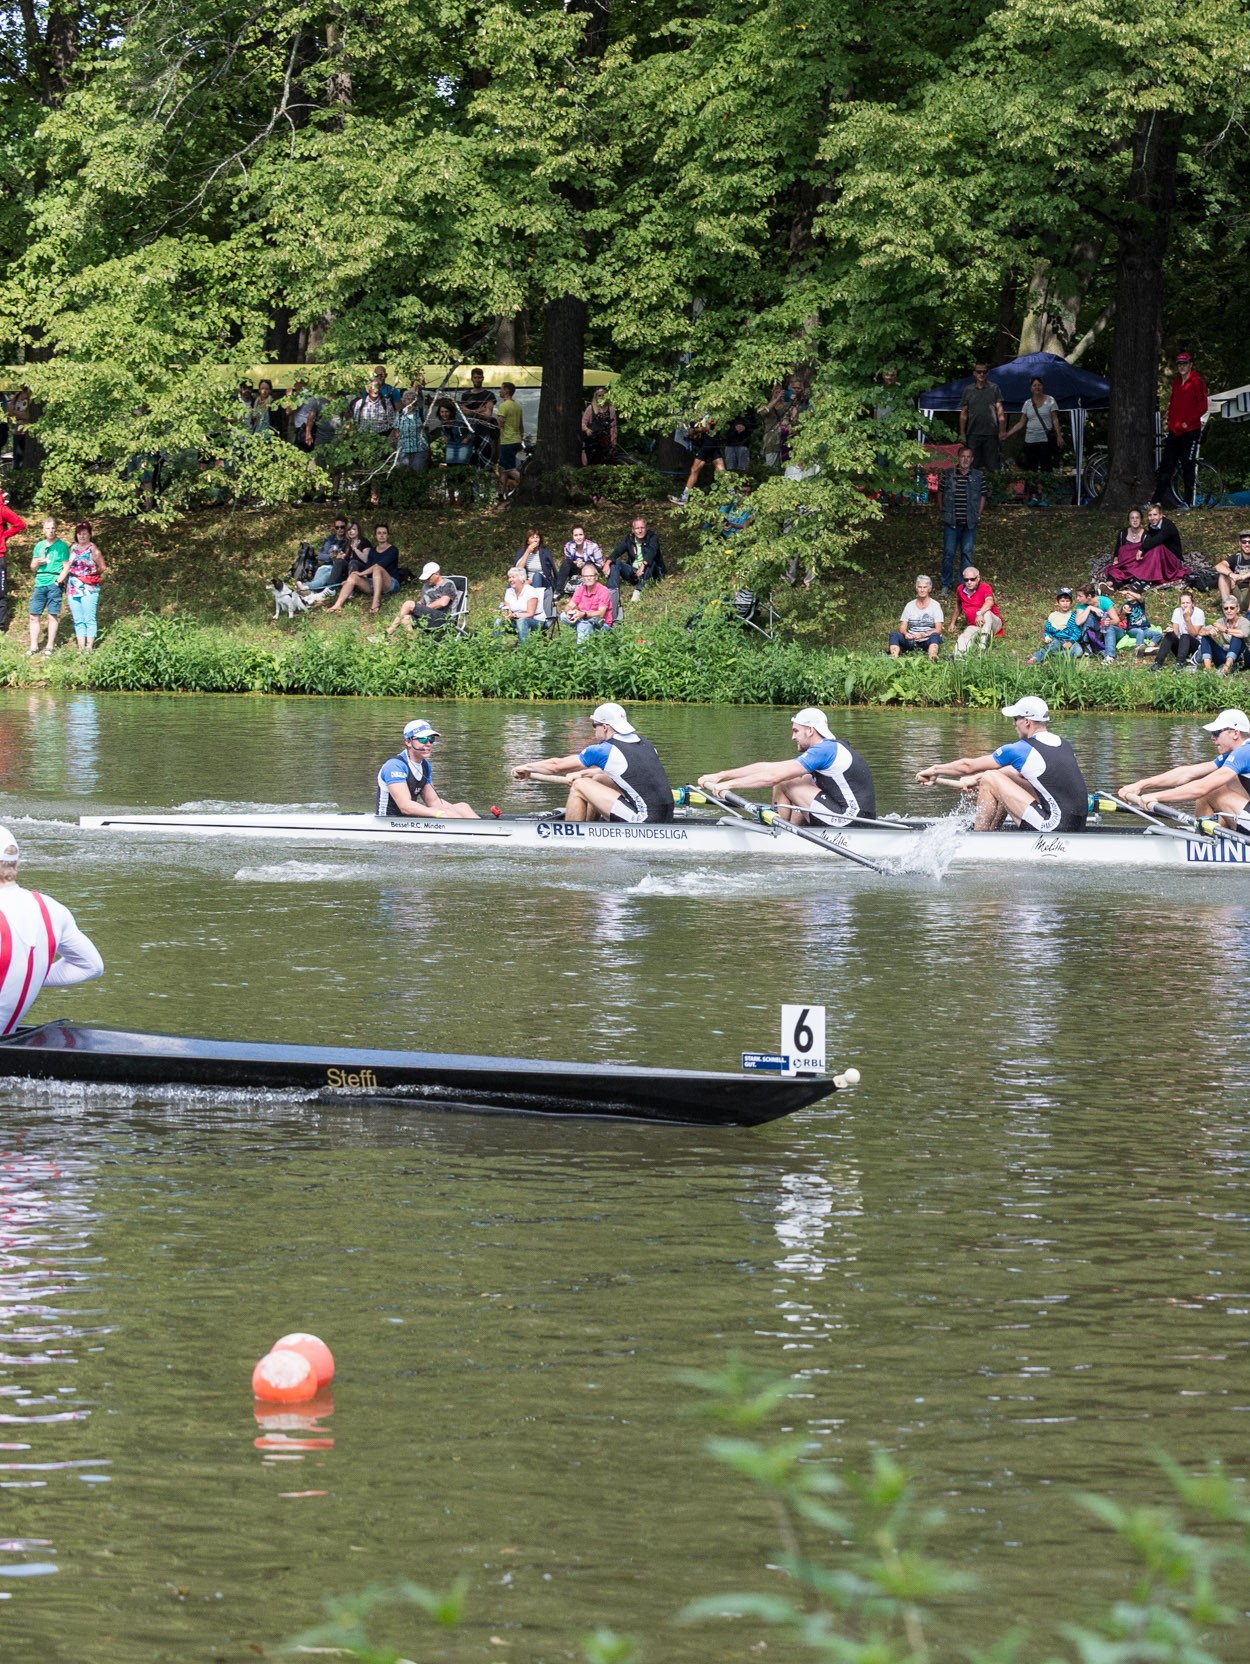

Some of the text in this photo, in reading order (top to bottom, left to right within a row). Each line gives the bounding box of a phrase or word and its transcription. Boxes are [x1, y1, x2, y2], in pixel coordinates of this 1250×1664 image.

[424, 822, 446, 830] Minden
[553, 823, 585, 836] RBL
[588, 827, 688, 840] RUDER-BUNDESLIGA
[1031, 834, 1066, 852] Melitta
[793, 1008, 814, 1053] 6
[803, 1058, 825, 1067] RBL
